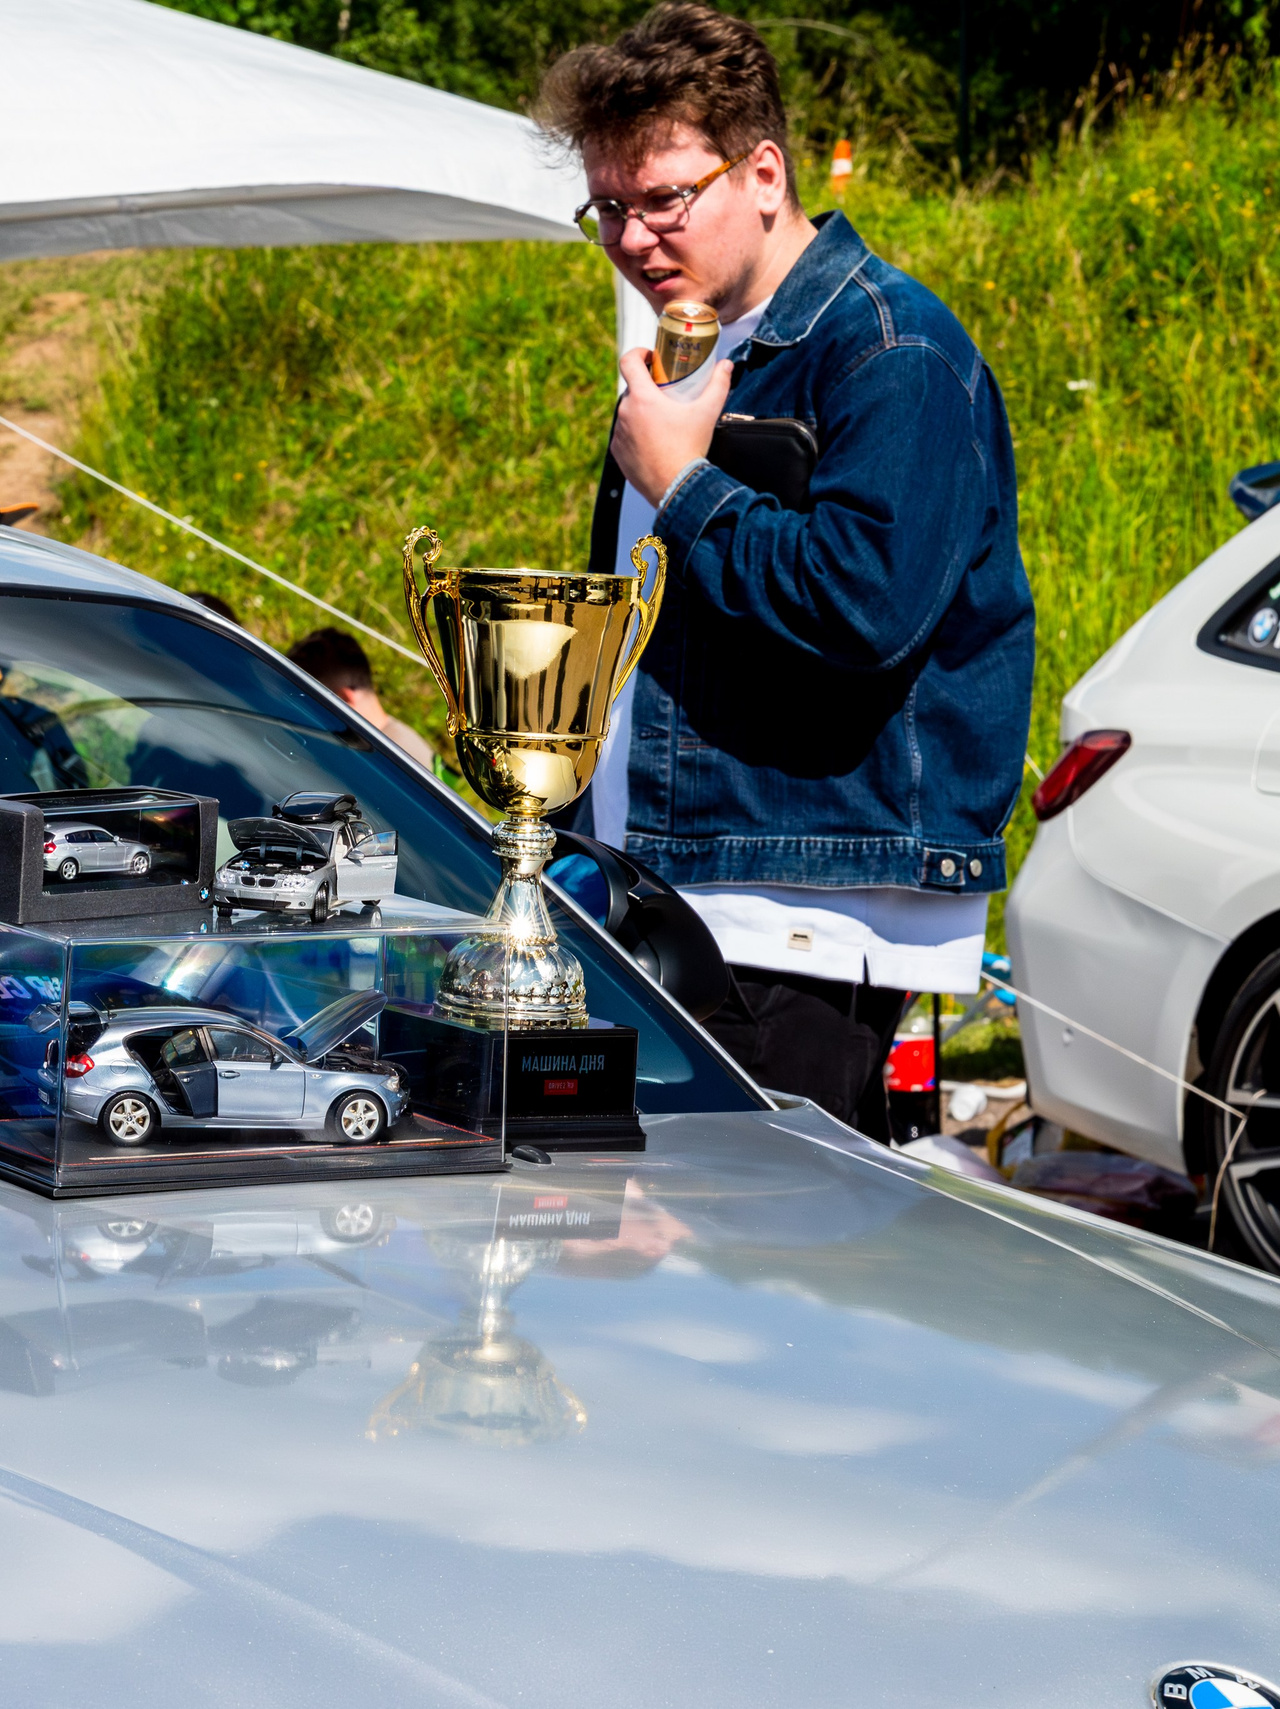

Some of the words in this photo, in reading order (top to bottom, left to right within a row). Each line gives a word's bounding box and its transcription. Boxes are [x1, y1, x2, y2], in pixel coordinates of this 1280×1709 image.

[521, 1055, 577, 1072] МАШИНА
[578, 1054, 605, 1074] ДНЯ
[1163, 1666, 1261, 1700] BMW
